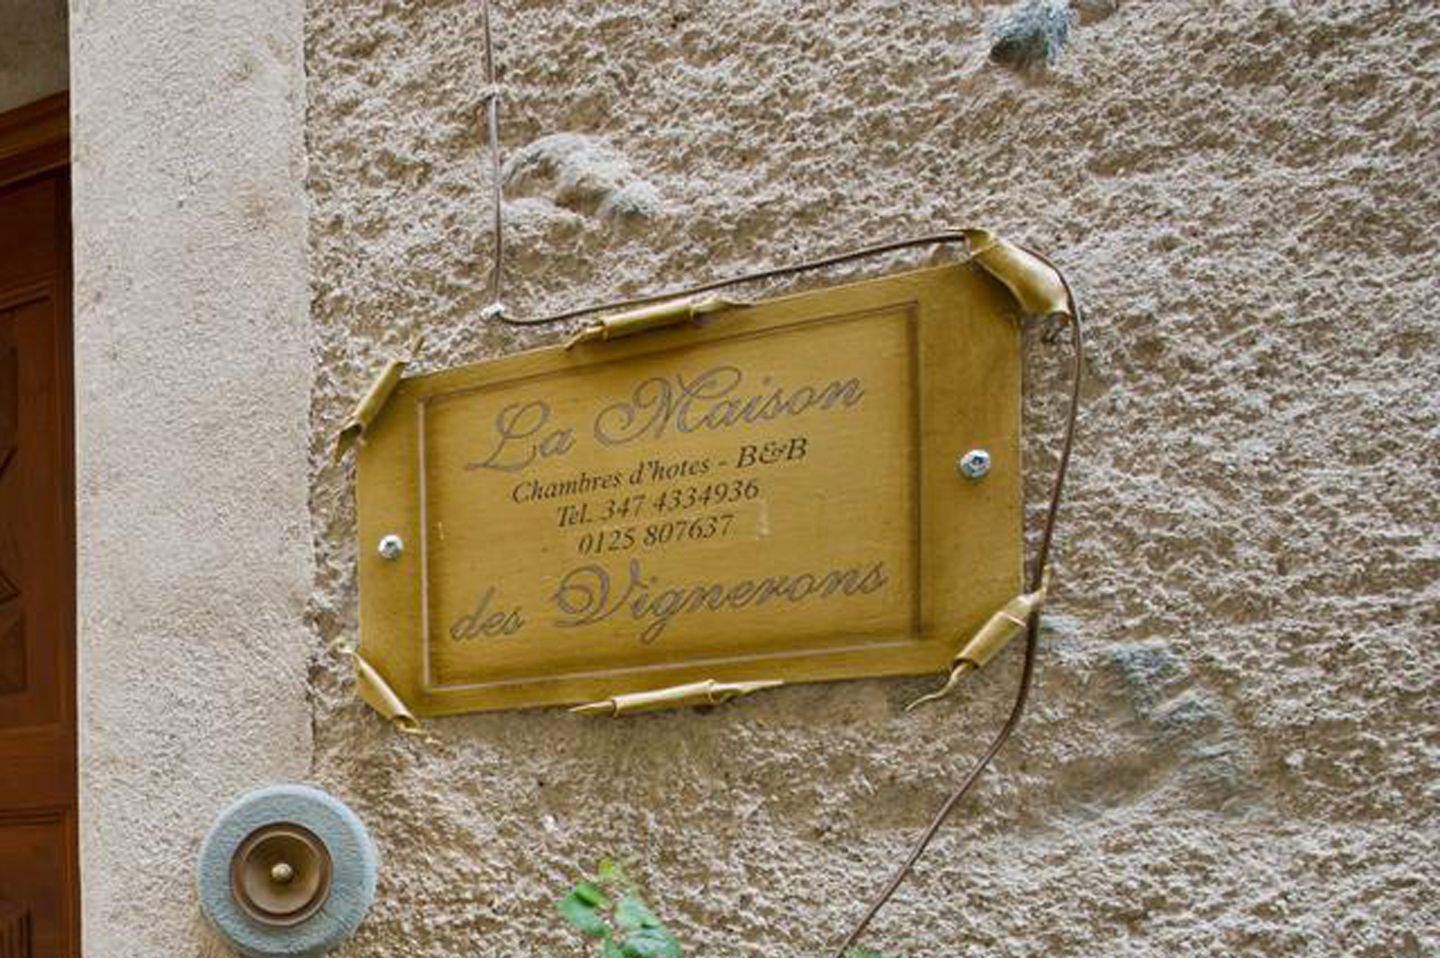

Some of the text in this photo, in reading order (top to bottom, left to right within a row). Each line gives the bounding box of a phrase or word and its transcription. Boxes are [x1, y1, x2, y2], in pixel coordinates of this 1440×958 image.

[464, 365, 865, 474] La Maison
[512, 471, 622, 504] Chambres
[736, 437, 808, 469] B&B
[600, 494, 646, 521] 347
[653, 480, 760, 512] 4334936
[578, 514, 735, 556] 0125 807637
[449, 557, 890, 645] des Vignerons
